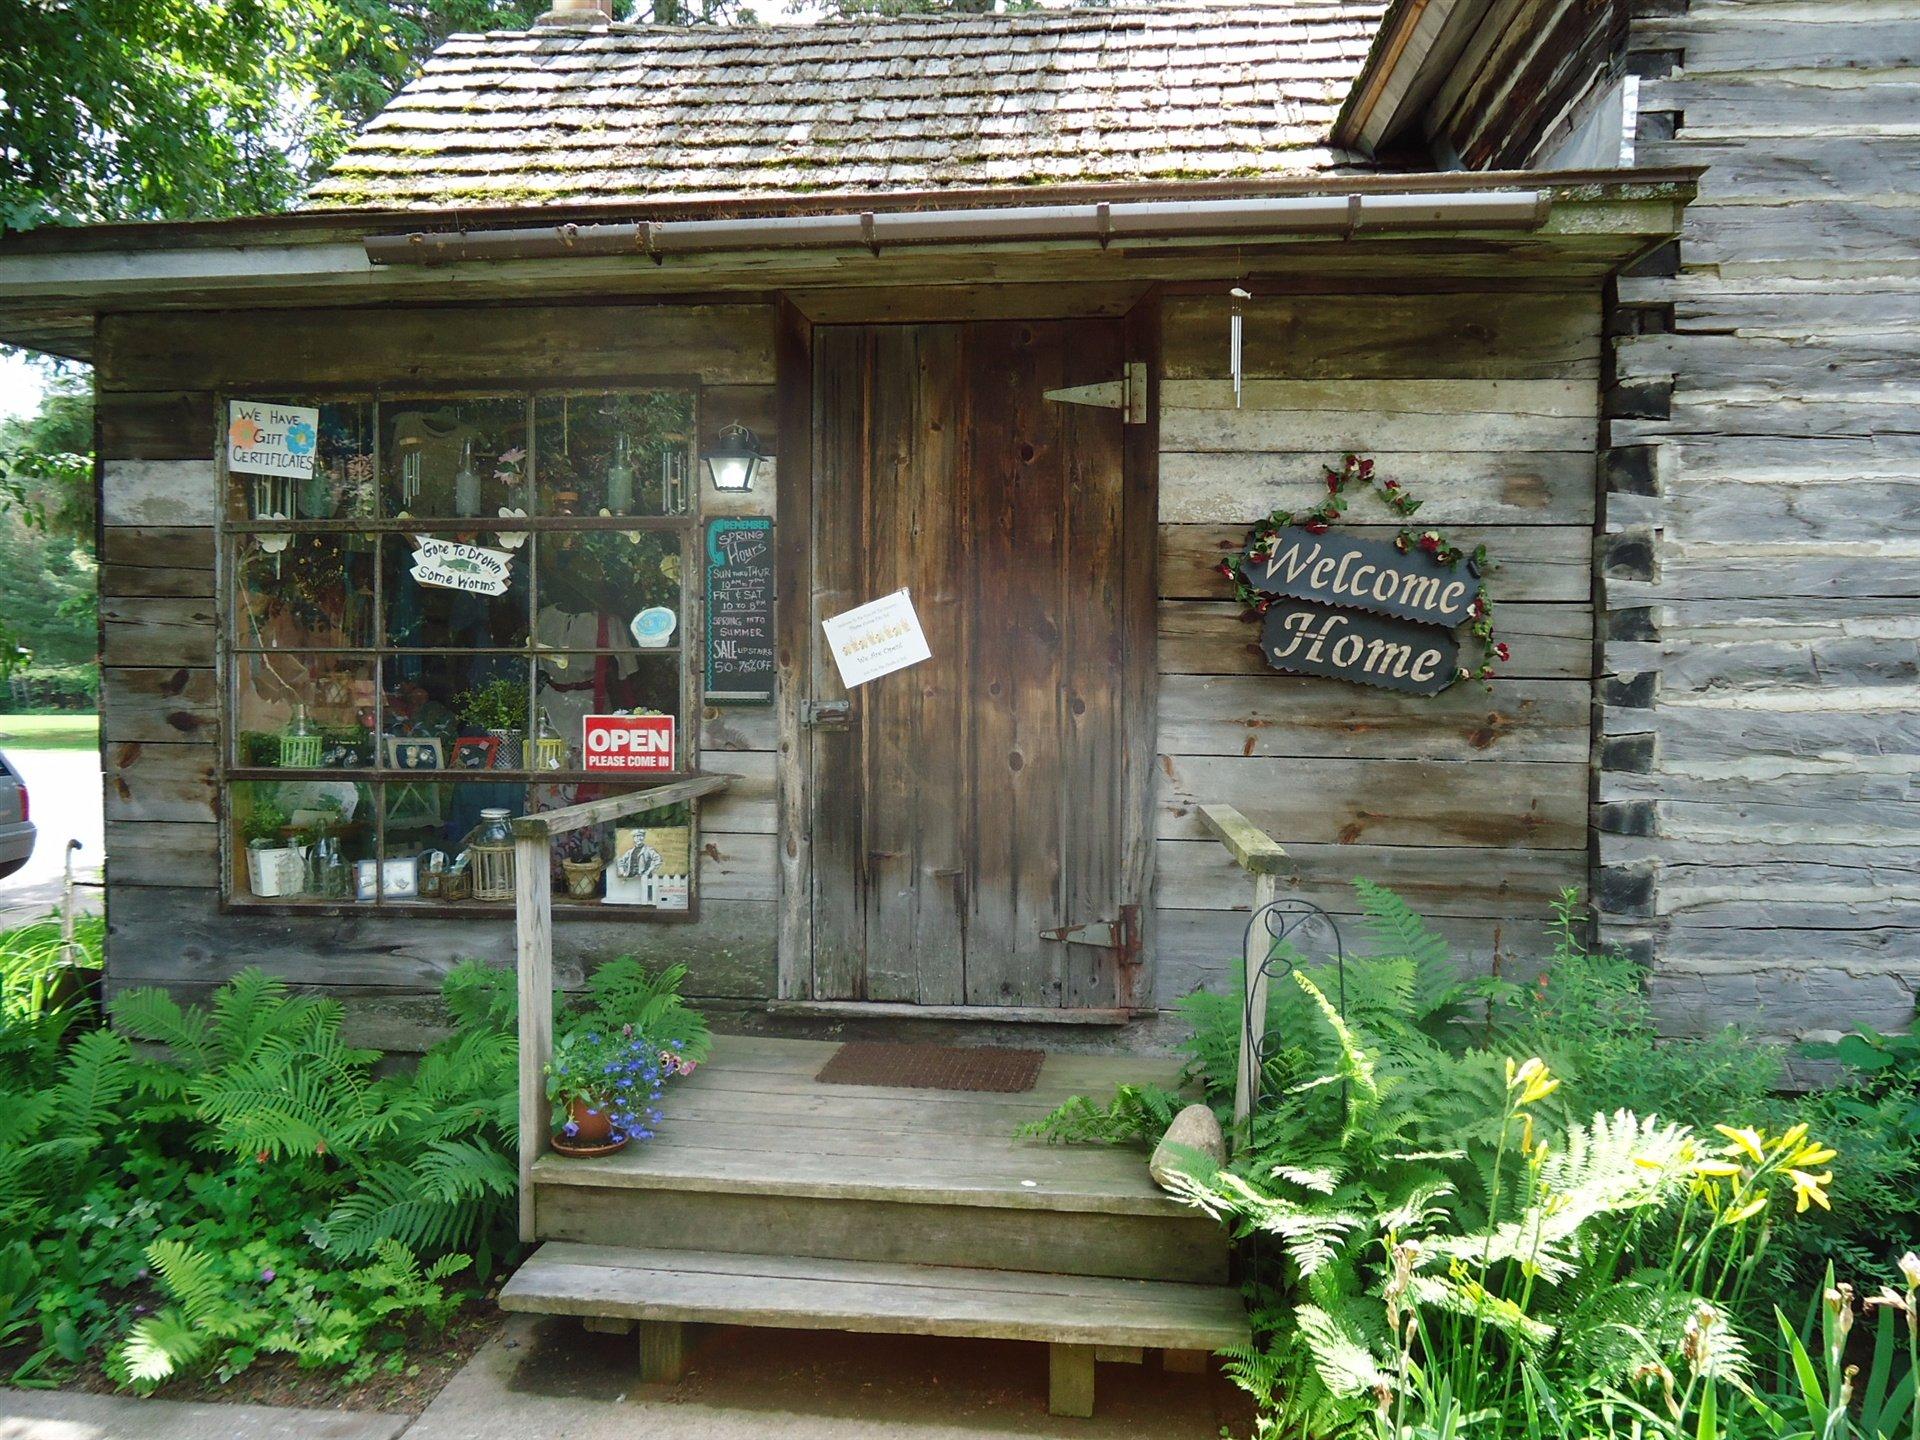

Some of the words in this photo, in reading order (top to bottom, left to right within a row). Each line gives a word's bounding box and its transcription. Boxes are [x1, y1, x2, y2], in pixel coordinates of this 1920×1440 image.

[239, 407, 262, 422] WE
[270, 410, 300, 426] HAVE
[253, 429, 283, 446] GIFT
[233, 445, 314, 471] CERTIFICATES
[718, 530, 765, 545] SPRING
[423, 541, 449, 558] Gone
[453, 544, 465, 557] To
[467, 547, 502, 575] Drown
[727, 541, 767, 567] Hours
[418, 566, 453, 585] Some
[458, 574, 496, 591] Worms
[713, 568, 731, 579] SUN
[1266, 537, 1465, 614] Welcome
[713, 591, 730, 600] FRI
[744, 590, 764, 600] SAT
[723, 602, 734, 610] 10
[720, 627, 765, 637] SUMMER
[713, 640, 737, 659] SALE
[1273, 612, 1442, 683] Home
[588, 728, 670, 753] OPEN
[589, 755, 626, 767] PLEASE
[627, 756, 657, 767] COME
[658, 756, 669, 767] IN
